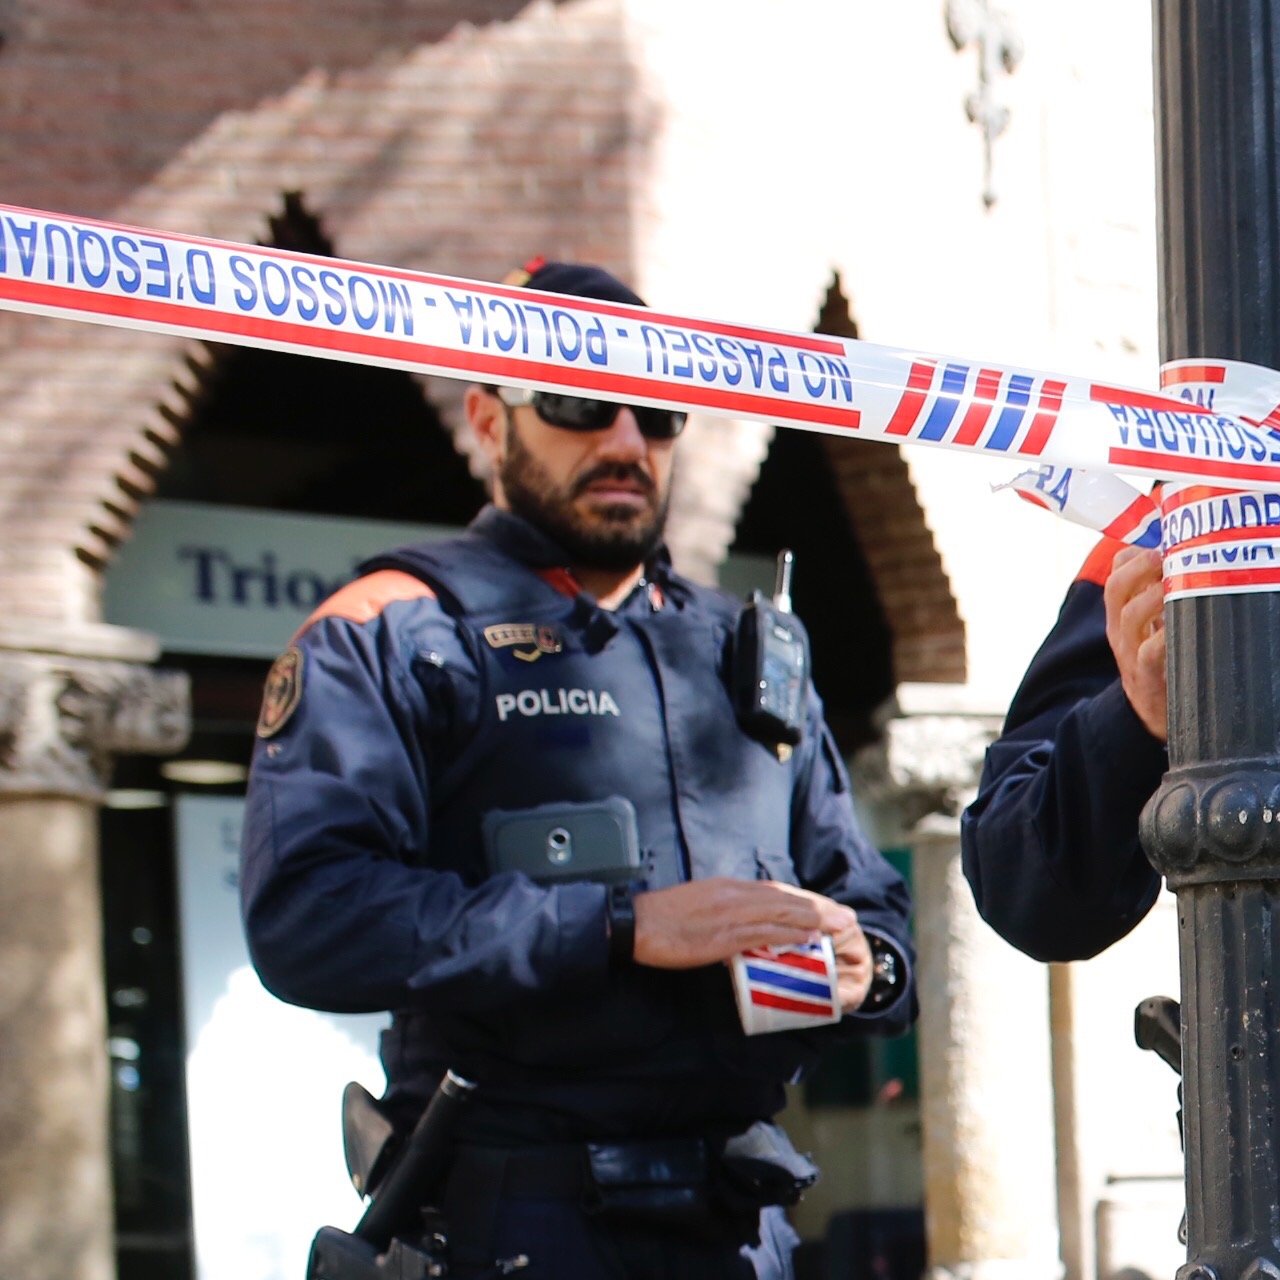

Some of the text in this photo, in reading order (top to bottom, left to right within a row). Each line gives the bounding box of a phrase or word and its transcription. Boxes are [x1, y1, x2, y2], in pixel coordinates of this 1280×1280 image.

[229, 255, 414, 337] MOSSOS
[444, 291, 608, 366] POLICIA
[641, 325, 790, 393] PASSEU
[797, 352, 853, 402] NO
[176, 543, 346, 609] Trio
[495, 687, 621, 722] POLICIA
